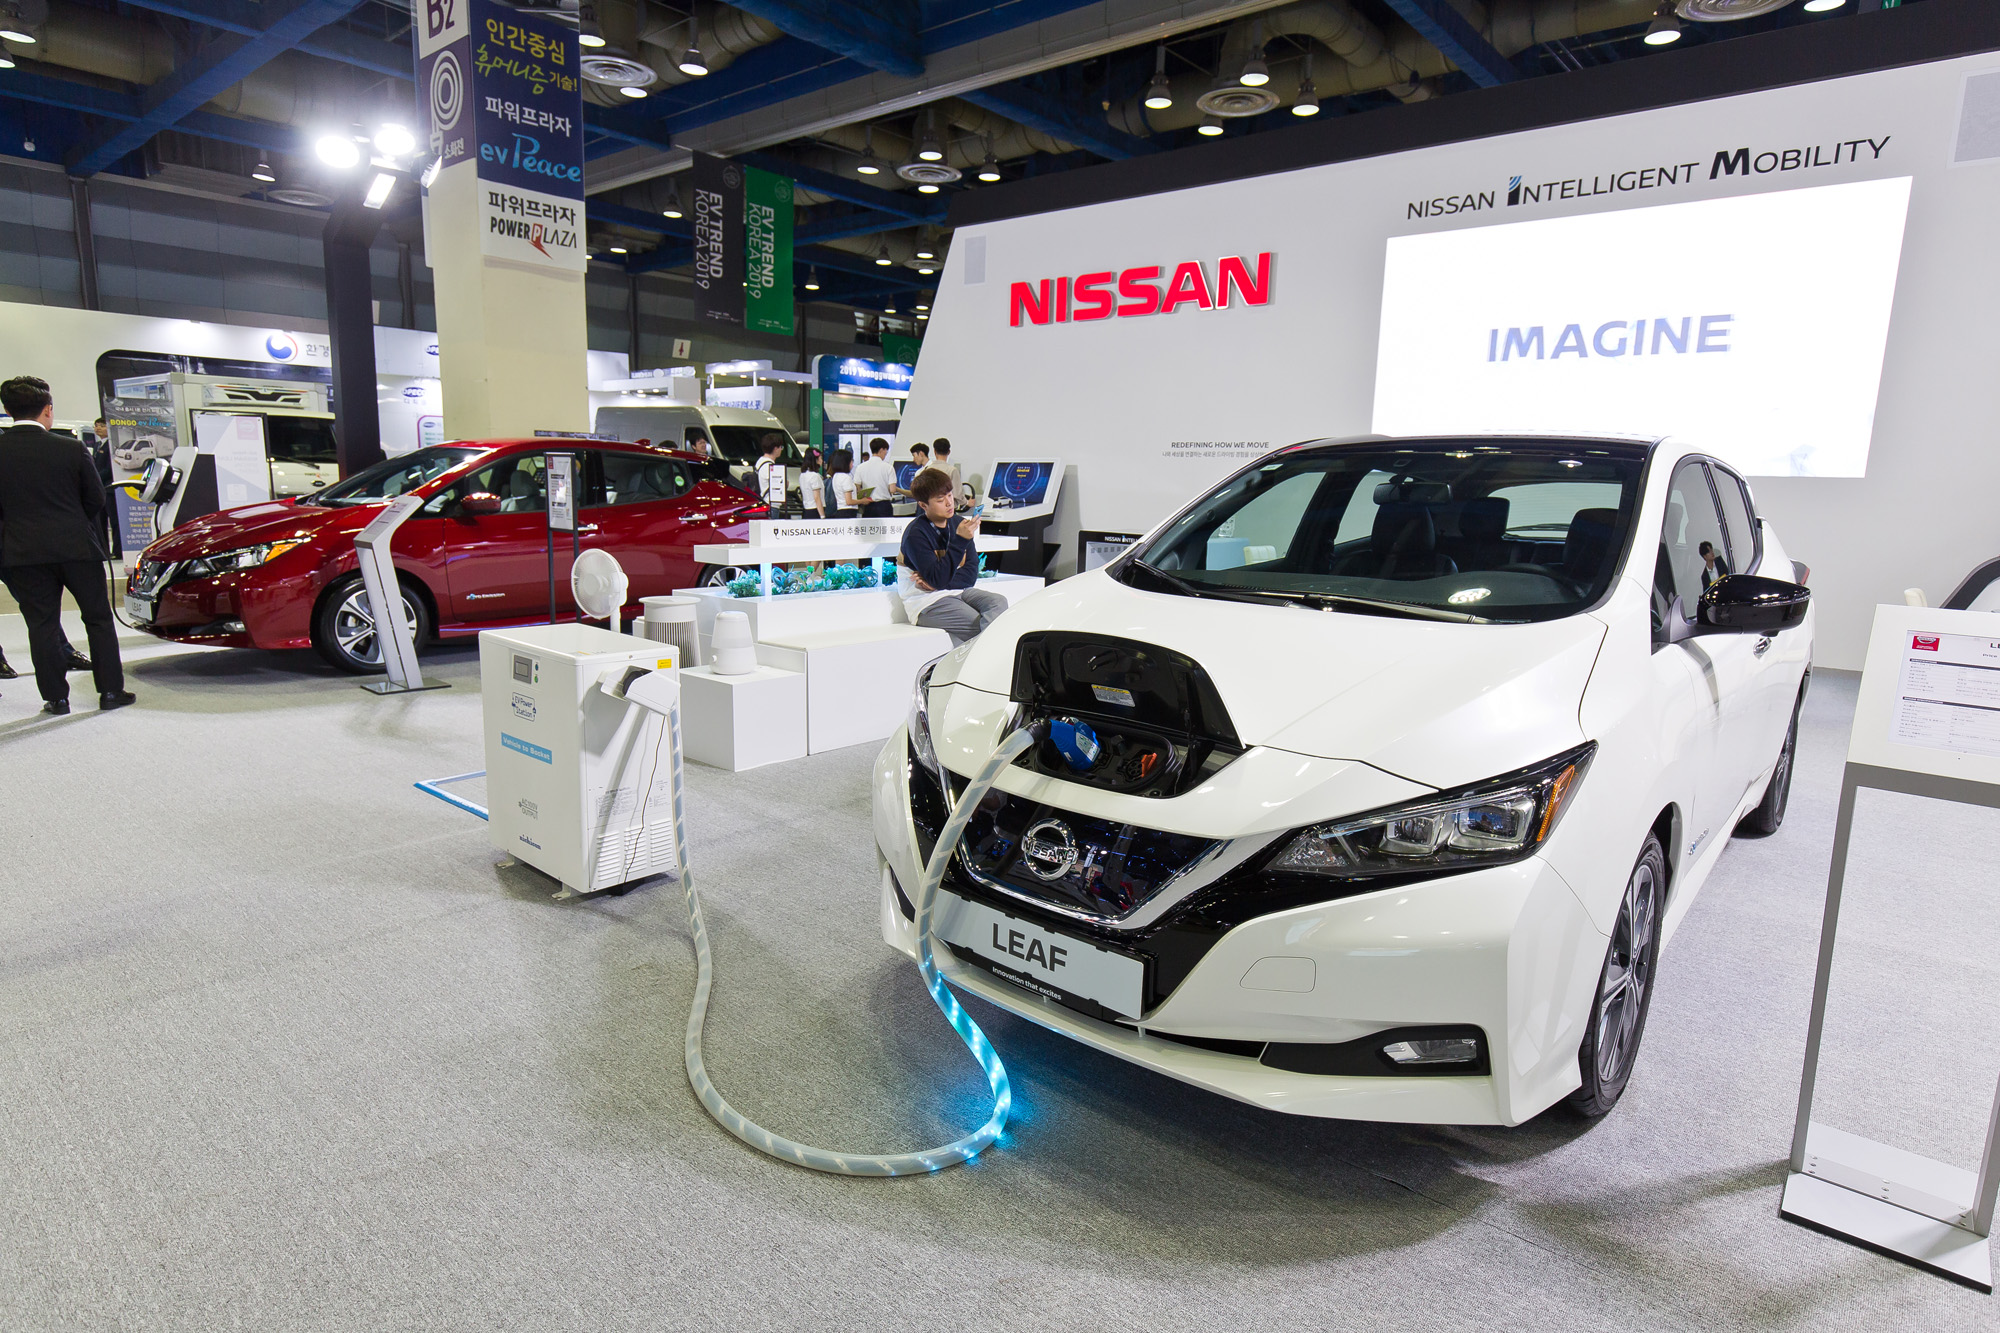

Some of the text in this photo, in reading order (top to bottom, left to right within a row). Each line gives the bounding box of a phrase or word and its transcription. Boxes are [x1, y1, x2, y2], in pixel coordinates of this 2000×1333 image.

[427, 0, 455, 39] B2
[486, 18, 565, 66] 인간중심
[475, 44, 577, 95] 휴머니즘 기술!
[485, 96, 572, 137] 파워프라자
[444, 137, 465, 159] 소화전
[1406, 190, 1495, 221] NISSAN
[1709, 136, 1891, 179] MOBILITY
[488, 191, 576, 226] 파워프라자
[695, 188, 710, 290] KOREA 2019
[709, 191, 723, 279] EV TREND
[748, 202, 762, 299] KOREA 2019
[761, 205, 775, 288] EV TREND
[1009, 251, 1272, 328] NISSAN
[1486, 312, 1736, 363] IMAGINE
[840, 365, 857, 376] 2019
[857, 366, 900, 383] Yeonggwang
[1171, 441, 1213, 449] REDEFINING
[781, 528, 811, 536] NISSAN
[812, 526, 845, 535] LEAF에서
[846, 526, 867, 535] 추출된
[868, 526, 887, 535] 전기를
[516, 706, 533, 718] Station
[502, 736, 550, 760] Vehicle to Socket
[1022, 836, 1078, 864] NISSAN
[992, 922, 1068, 972] LEAF
[992, 966, 1062, 1000] Innovation that excites
